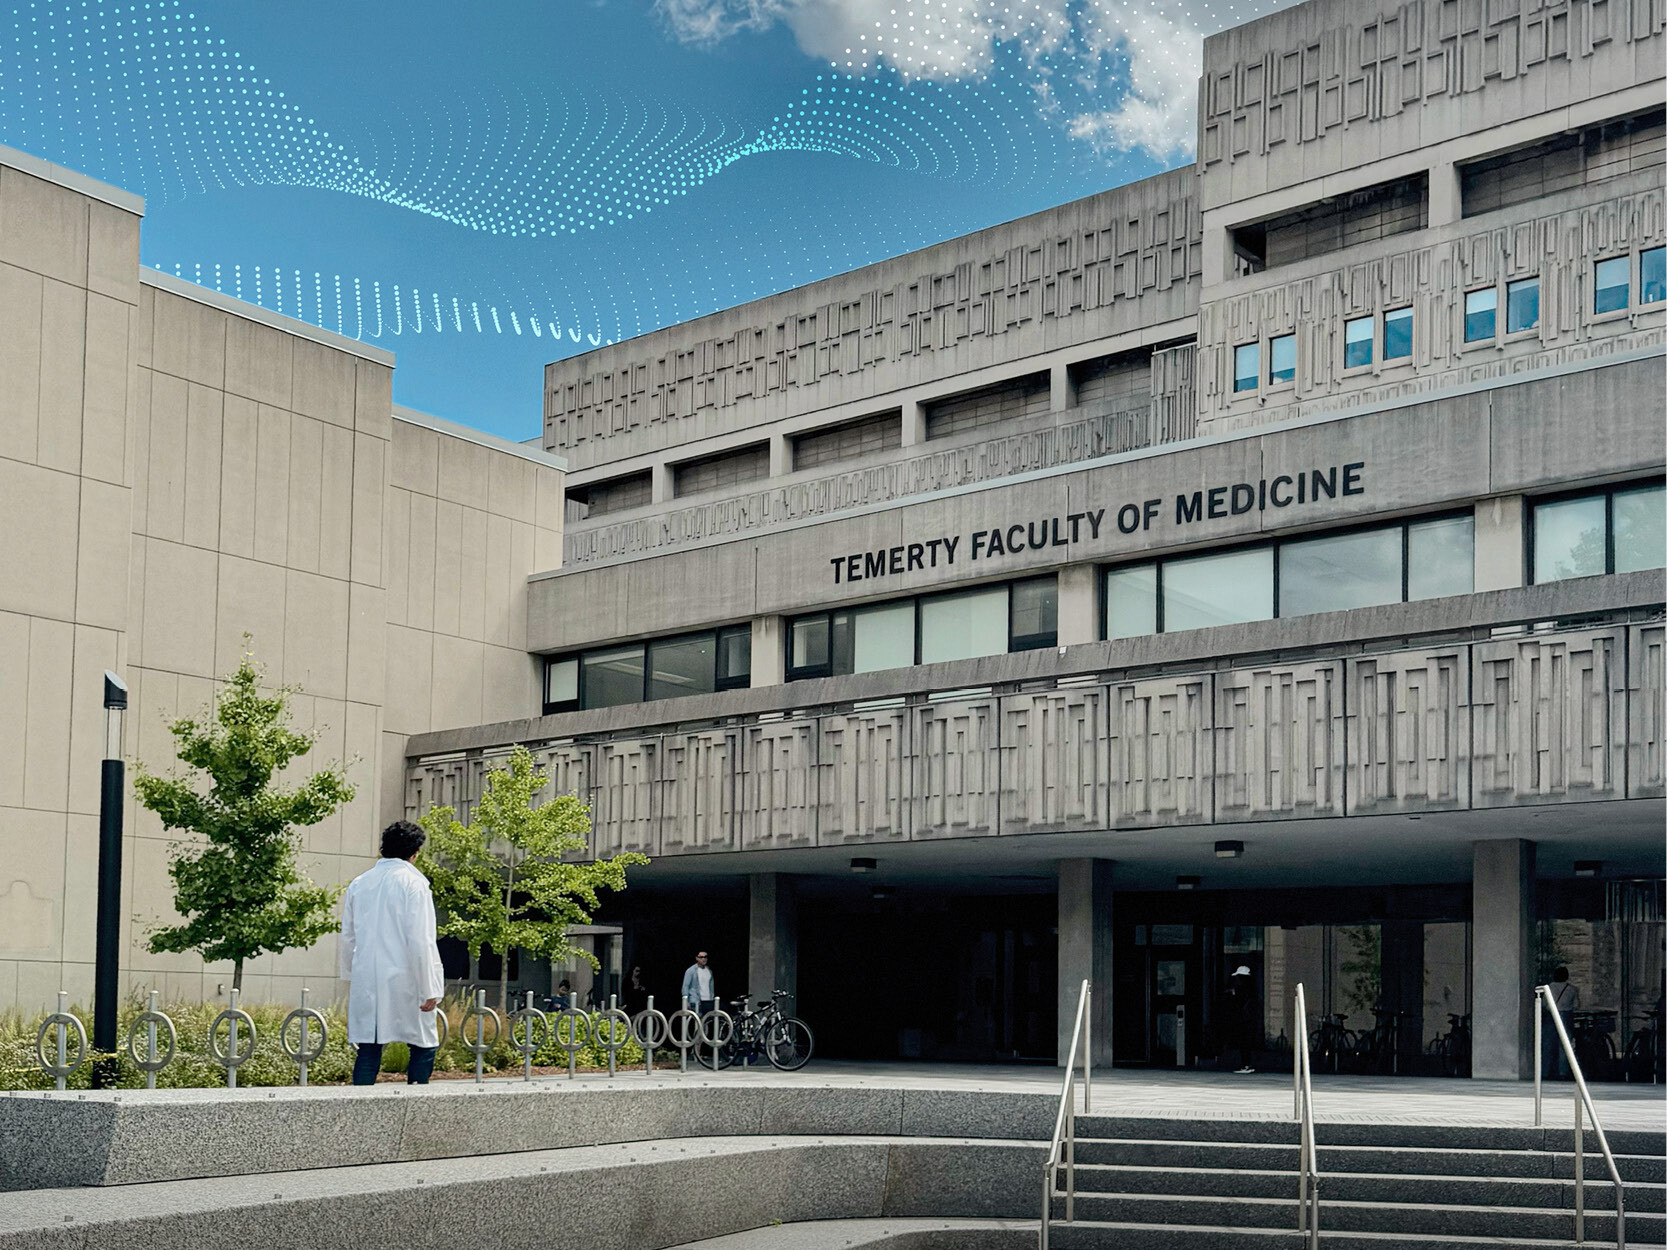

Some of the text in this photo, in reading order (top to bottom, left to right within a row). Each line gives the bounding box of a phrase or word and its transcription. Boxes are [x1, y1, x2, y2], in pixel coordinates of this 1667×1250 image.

[830, 461, 1365, 585] TEMERTY FACULTY OF MEDICINE
